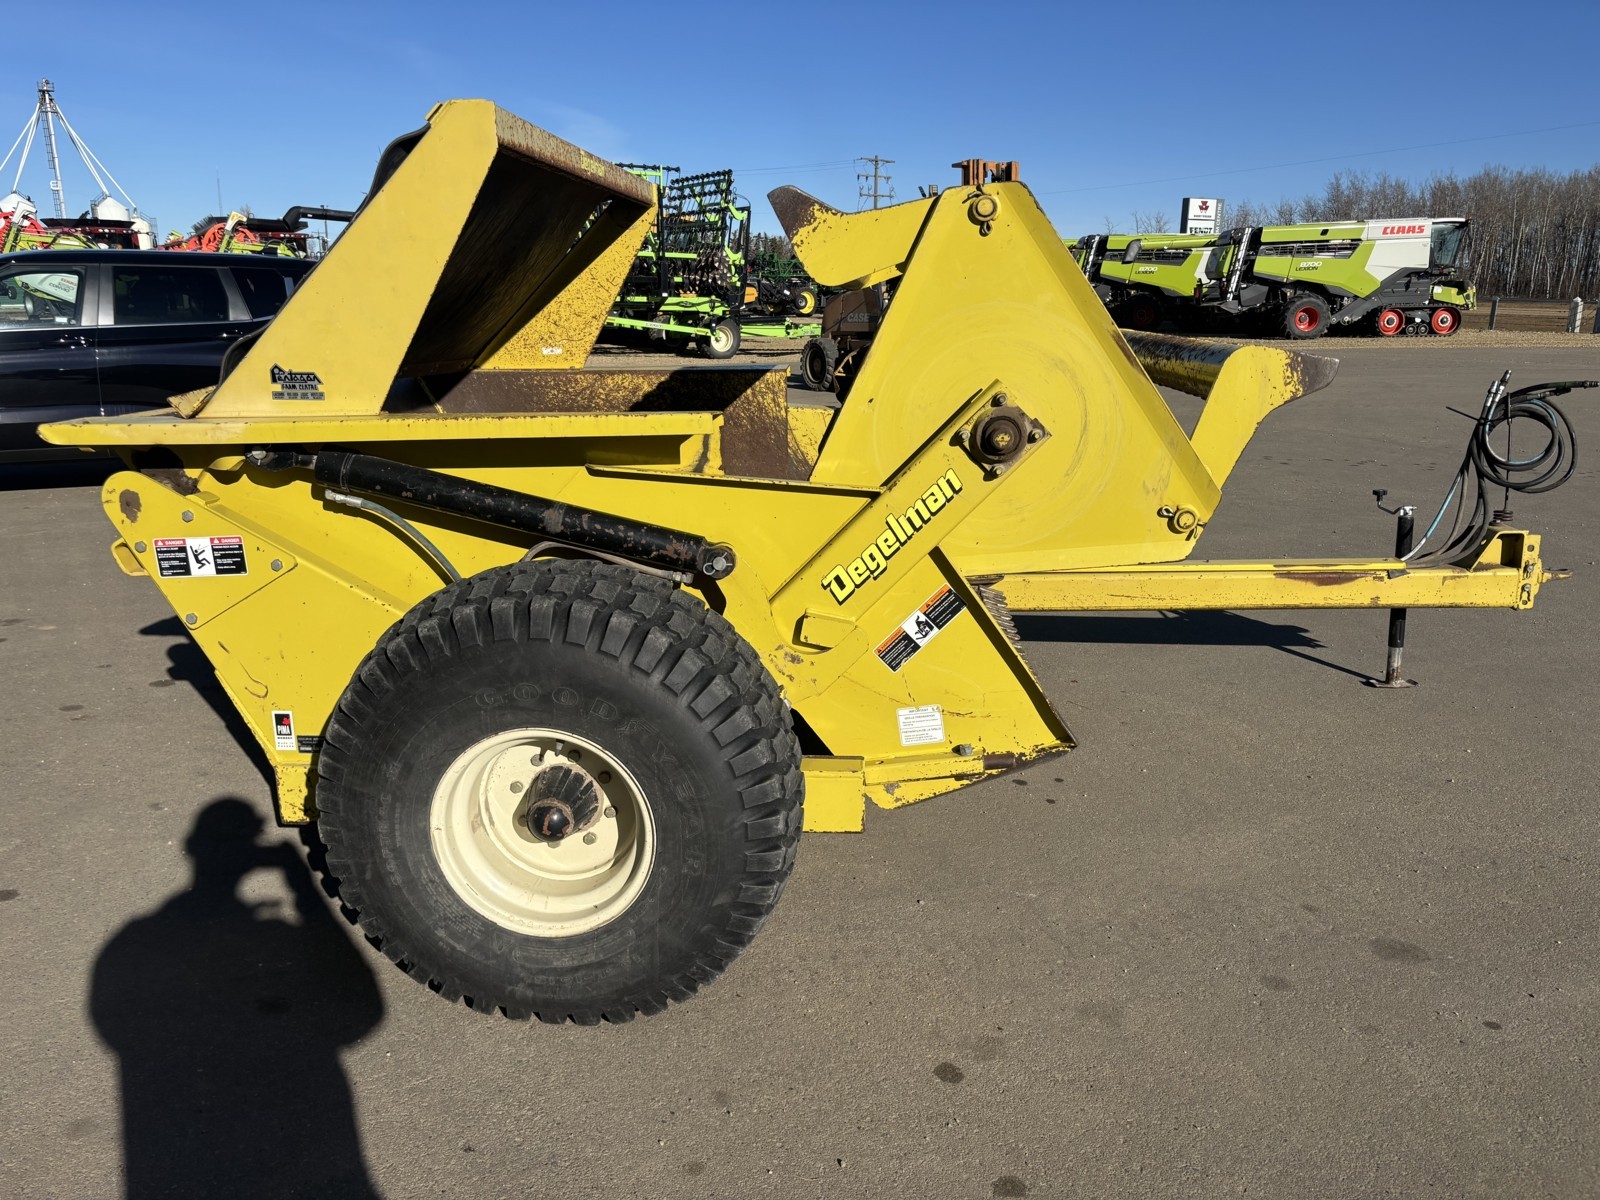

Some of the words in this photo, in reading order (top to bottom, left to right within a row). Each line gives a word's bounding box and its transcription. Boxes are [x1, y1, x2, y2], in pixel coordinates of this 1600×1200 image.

[1382, 225, 1425, 236] CLAAS
[847, 312, 870, 322] CASE
[270, 365, 322, 384] Pentagon
[821, 468, 963, 606] Degelman
